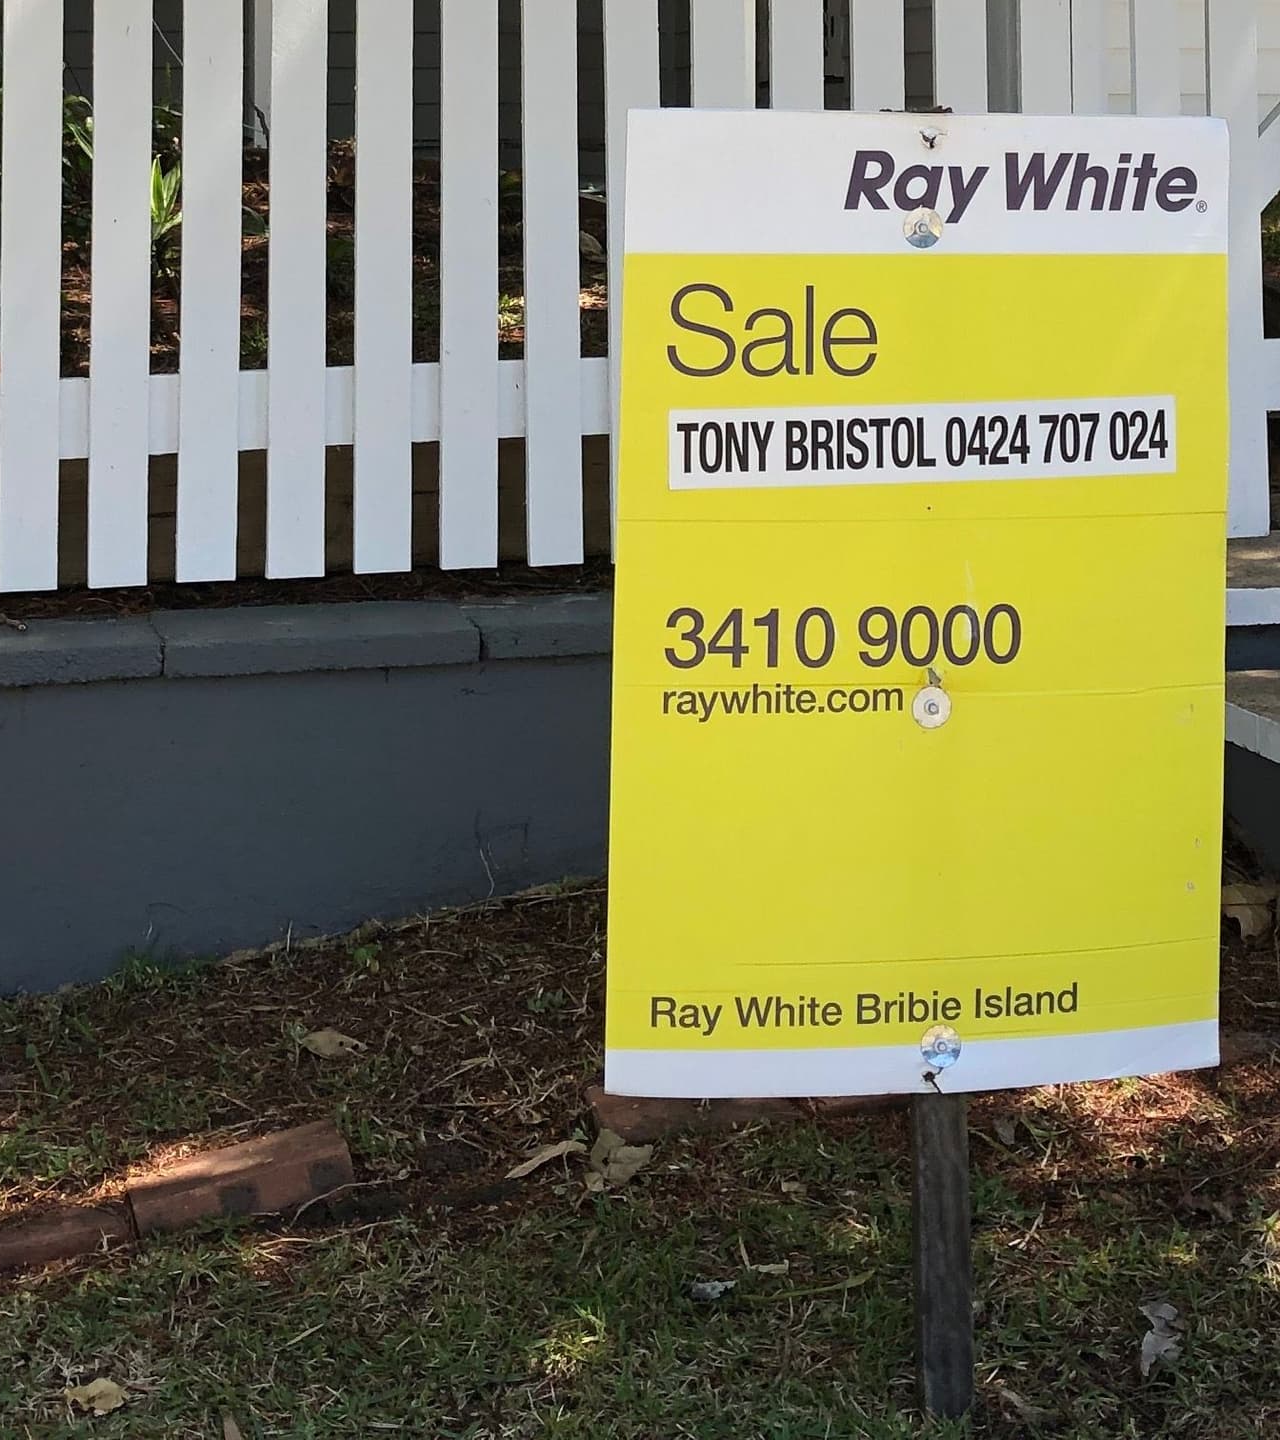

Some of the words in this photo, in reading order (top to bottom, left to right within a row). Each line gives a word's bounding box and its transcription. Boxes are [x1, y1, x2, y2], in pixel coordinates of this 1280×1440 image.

[843, 150, 989, 224] Ray
[1004, 152, 1198, 213] White
[666, 283, 878, 378] Sale
[676, 420, 775, 474] TONY
[785, 416, 937, 472] BRISTOL
[945, 414, 1030, 467] 0424
[1038, 412, 1100, 464] 707
[1109, 409, 1169, 461] 024
[664, 606, 835, 669] 3410
[858, 603, 1022, 667] 9000
[661, 683, 904, 723] raywhite.com
[650, 996, 723, 1037] Ray
[734, 995, 843, 1028] White
[856, 990, 962, 1025] Bribie
[973, 981, 1079, 1019] Island
